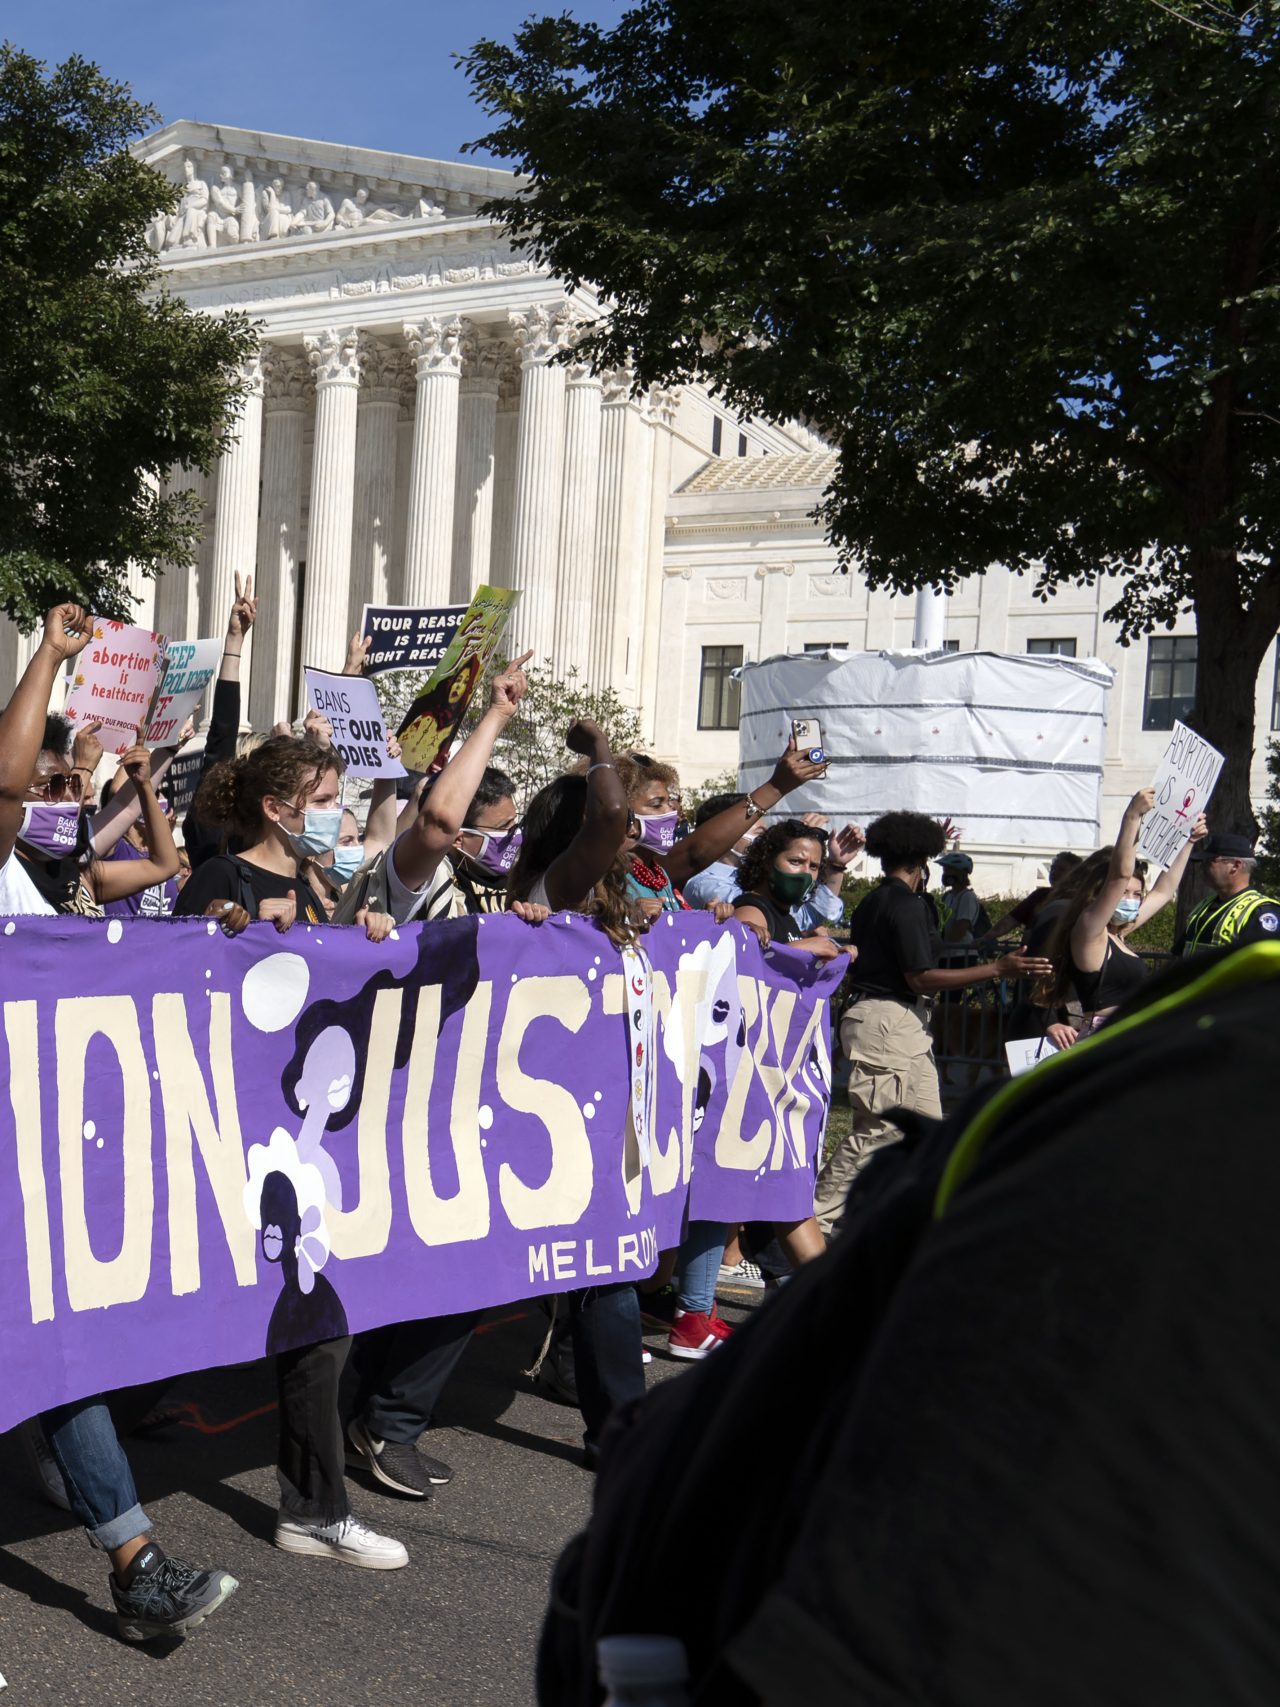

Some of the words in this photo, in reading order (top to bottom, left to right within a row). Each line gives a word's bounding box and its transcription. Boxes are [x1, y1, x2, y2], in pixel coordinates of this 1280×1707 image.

[372, 616, 412, 631] YOUR
[418, 614, 466, 629] REASO
[394, 635, 410, 647] IS
[416, 632, 445, 645] THE
[92, 646, 151, 672] abortion
[364, 650, 405, 667] RIGHT
[409, 647, 448, 660] REAS
[120, 670, 129, 686] is
[91, 683, 145, 704] healthcare
[314, 688, 351, 714] BANS
[105, 717, 117, 726] DUE
[144, 719, 178, 742] ODY
[327, 717, 347, 739] FF
[349, 719, 384, 742] OUR
[337, 744, 383, 768] ODIES
[1163, 724, 1220, 795] ABORTION
[1157, 775, 1176, 805] IS
[52, 832, 77, 846] BODI
[56, 825, 73, 836] OFF
[1139, 810, 1189, 869] ALTHCARE
